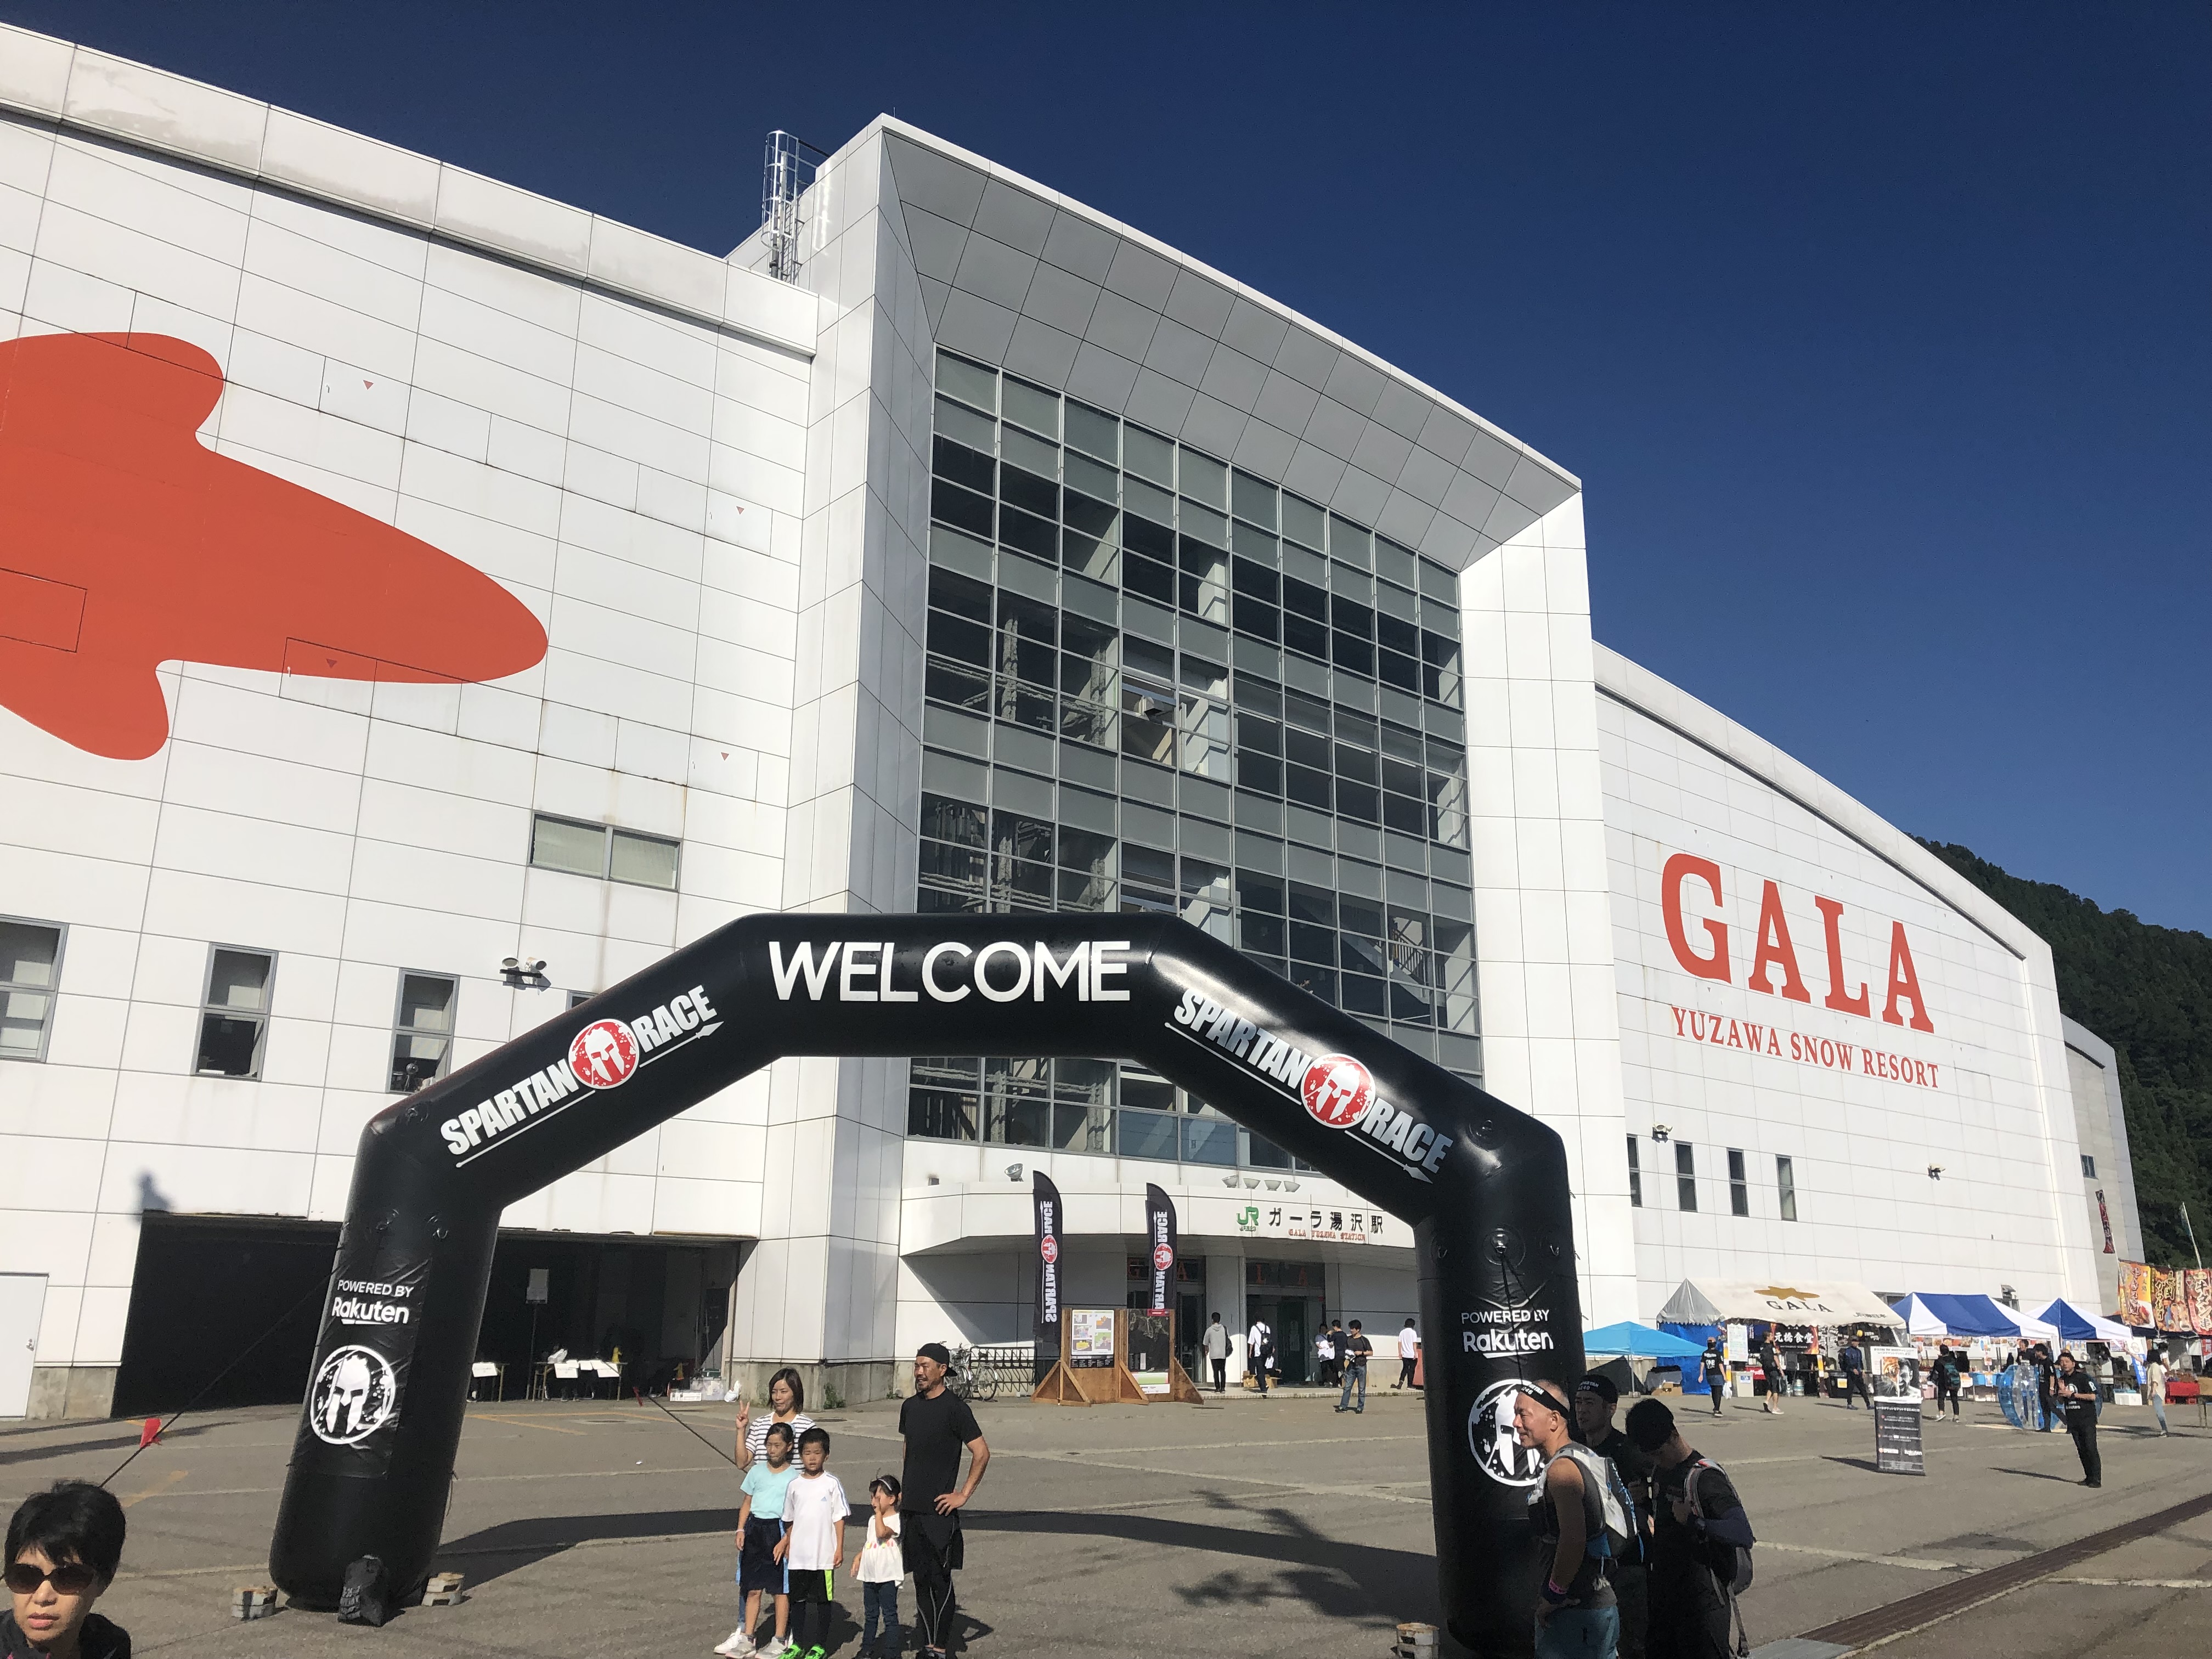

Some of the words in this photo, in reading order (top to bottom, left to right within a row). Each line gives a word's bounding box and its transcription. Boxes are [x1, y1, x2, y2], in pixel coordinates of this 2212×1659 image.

[1661, 853, 1934, 1034] GALA
[769, 940, 1130, 1002] WELCOME
[1671, 1006, 1782, 1057] YUZAWA
[1790, 1031, 1853, 1071] SNOW
[1863, 1048, 1939, 1088] RESORT
[441, 1058, 579, 1155] SPARTAN
[631, 985, 718, 1053] RACE
[1174, 988, 1313, 1090] SPARTAN
[1361, 1098, 1453, 1174] RACE
[1237, 1206, 1259, 1226] JR
[1268, 1207, 1383, 1235] ガーラ湯沢駅
[1288, 1228, 1306, 1237] GALA
[1340, 1232, 1365, 1242] STATION
[337, 1279, 392, 1295] POWERED
[395, 1285, 414, 1297] BY
[331, 1297, 410, 1324] Rakuten
[1462, 1310, 1531, 1324] POWERED
[1534, 1310, 1550, 1322] BY
[1767, 1301, 1834, 1313] GALA
[1463, 1329, 1554, 1352] Rakuten
